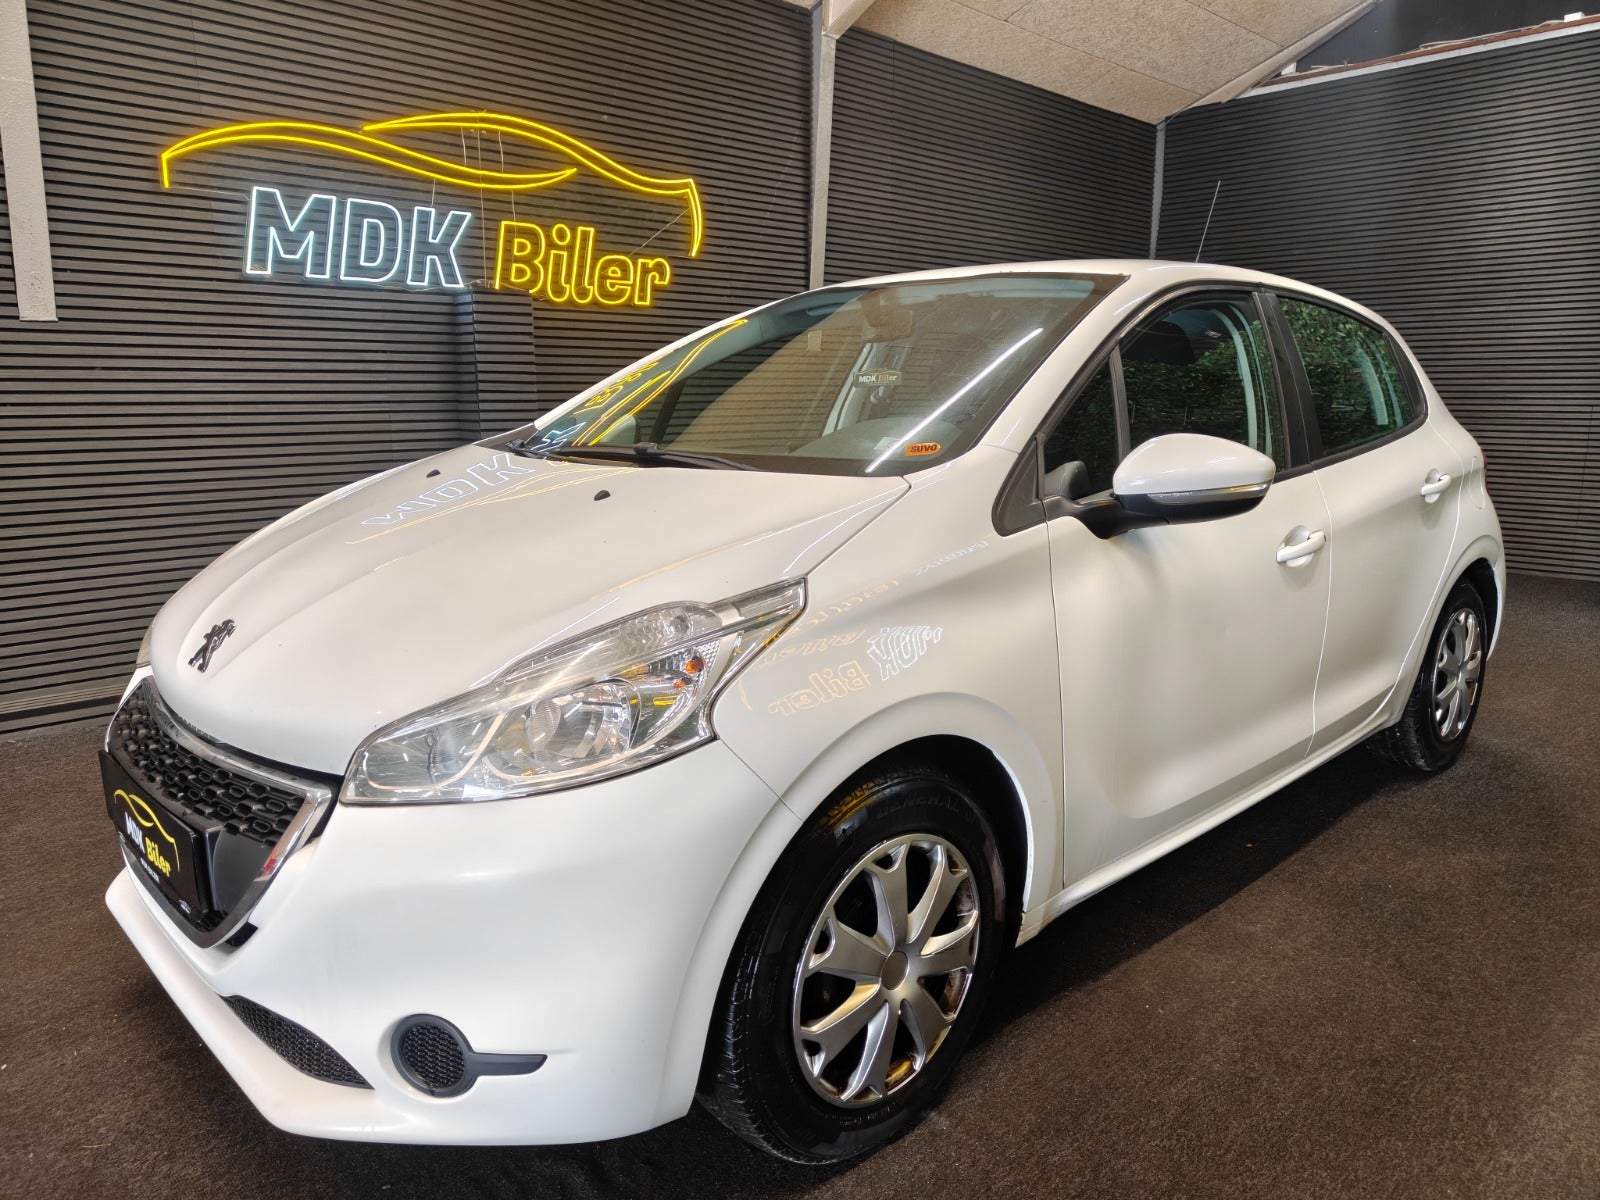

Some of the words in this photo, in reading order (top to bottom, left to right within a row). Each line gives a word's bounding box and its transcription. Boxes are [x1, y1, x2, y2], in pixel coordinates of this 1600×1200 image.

[244, 185, 473, 289] MDK
[494, 220, 671, 305] Biler
[858, 374, 877, 383] MDK
[910, 443, 938, 453] SUVO
[124, 811, 146, 854] MDK
[145, 837, 171, 878] Biler
